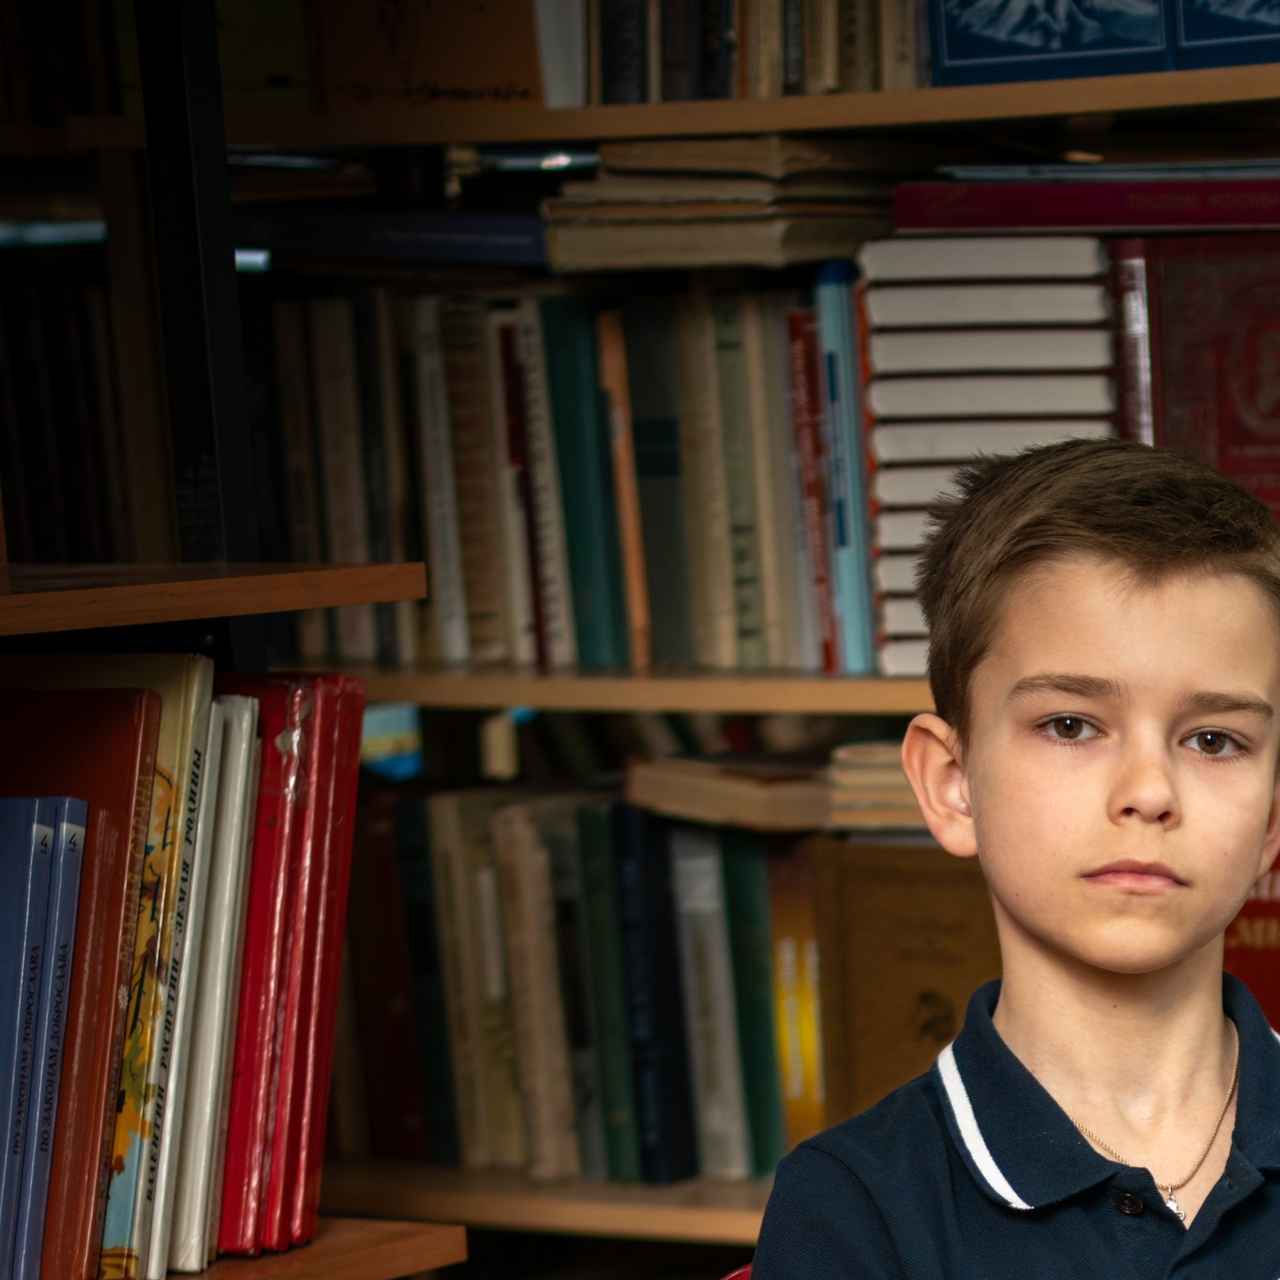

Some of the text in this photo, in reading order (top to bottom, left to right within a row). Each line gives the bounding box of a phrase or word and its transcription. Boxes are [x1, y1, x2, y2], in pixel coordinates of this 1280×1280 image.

[118, 872, 143, 963] РОДНАЯ
[130, 774, 154, 859] СТРАНА
[13, 944, 41, 1156] ПО ЗАКОНАМ ДОБРОСЛАВА
[39, 943, 70, 1154] ПО ЗАКОНАМ ДОБРОСЛАВА
[145, 747, 204, 1203] ВАЛЕНТИН РАСПУТИН ЗЕМЛЯ РОДИНЫ
